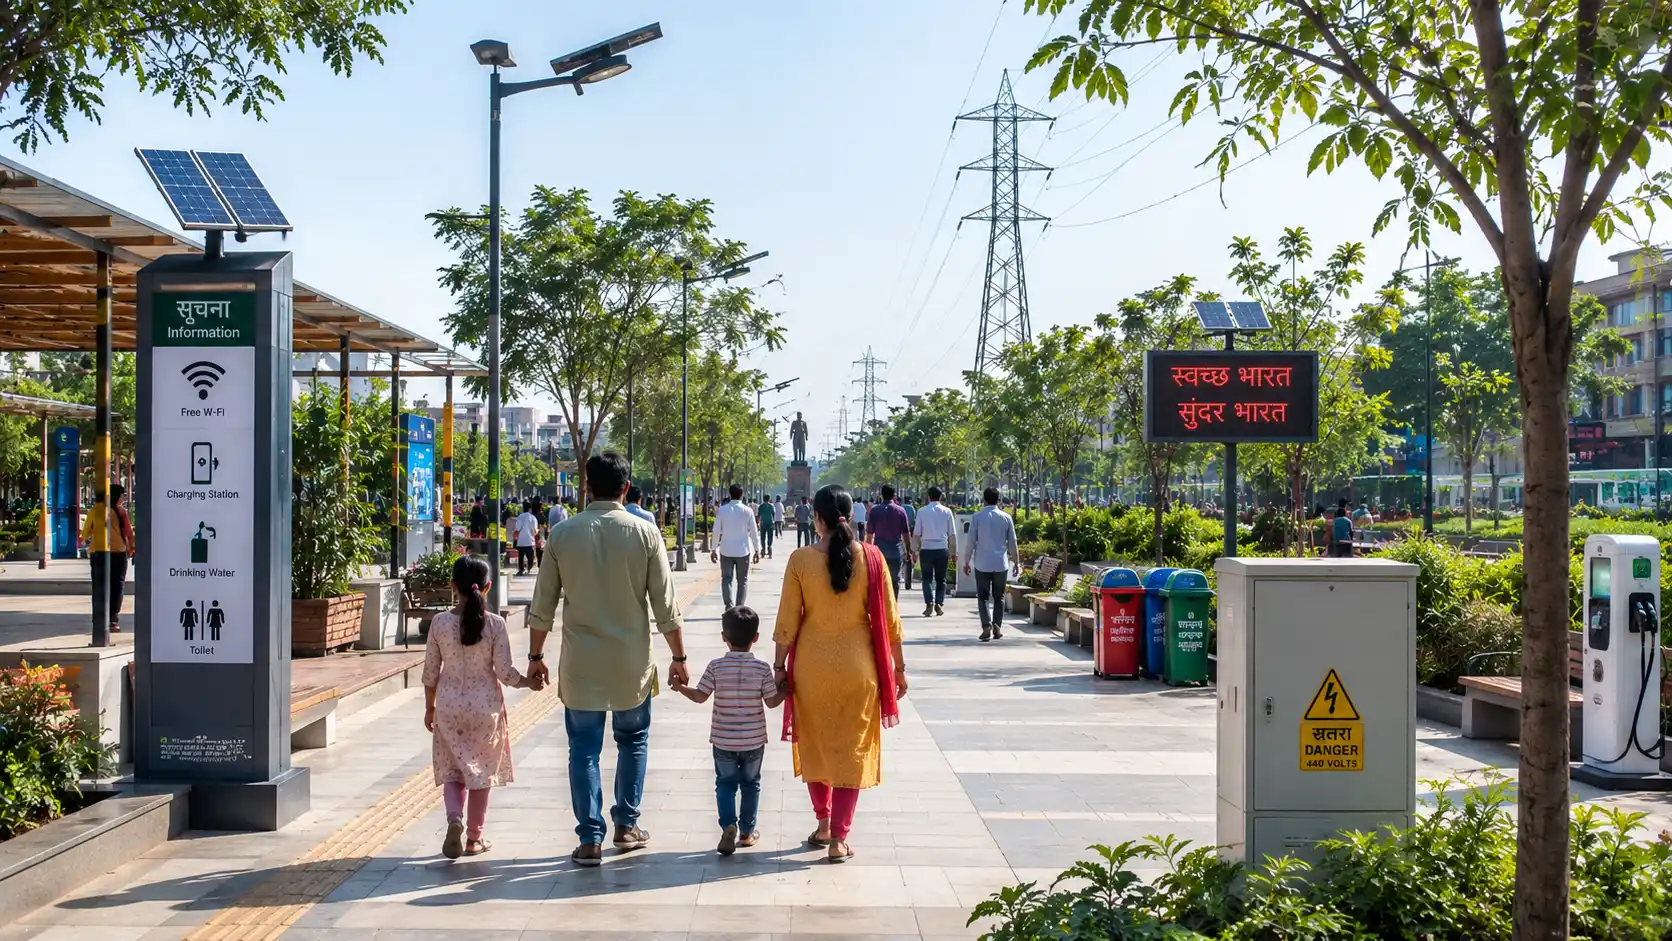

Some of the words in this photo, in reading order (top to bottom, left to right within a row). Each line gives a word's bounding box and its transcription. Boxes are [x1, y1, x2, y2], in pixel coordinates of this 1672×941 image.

[176, 300, 231, 325] सूचना
[167, 325, 240, 338] Information
[1171, 366, 1230, 387] स्वच्छ
[1238, 366, 1292, 387] भारत
[181, 407, 201, 417] Free
[1177, 397, 1226, 430] सुंदर
[1234, 402, 1288, 423] भारत
[166, 489, 206, 501] Charging
[208, 489, 239, 499] Station
[169, 567, 206, 579] Drinking
[208, 568, 236, 578] Water
[189, 645, 215, 655] Toilet
[1305, 745, 1358, 756] DANGER
[1306, 759, 1324, 768] 440
[1327, 759, 1358, 768] VOLTS
